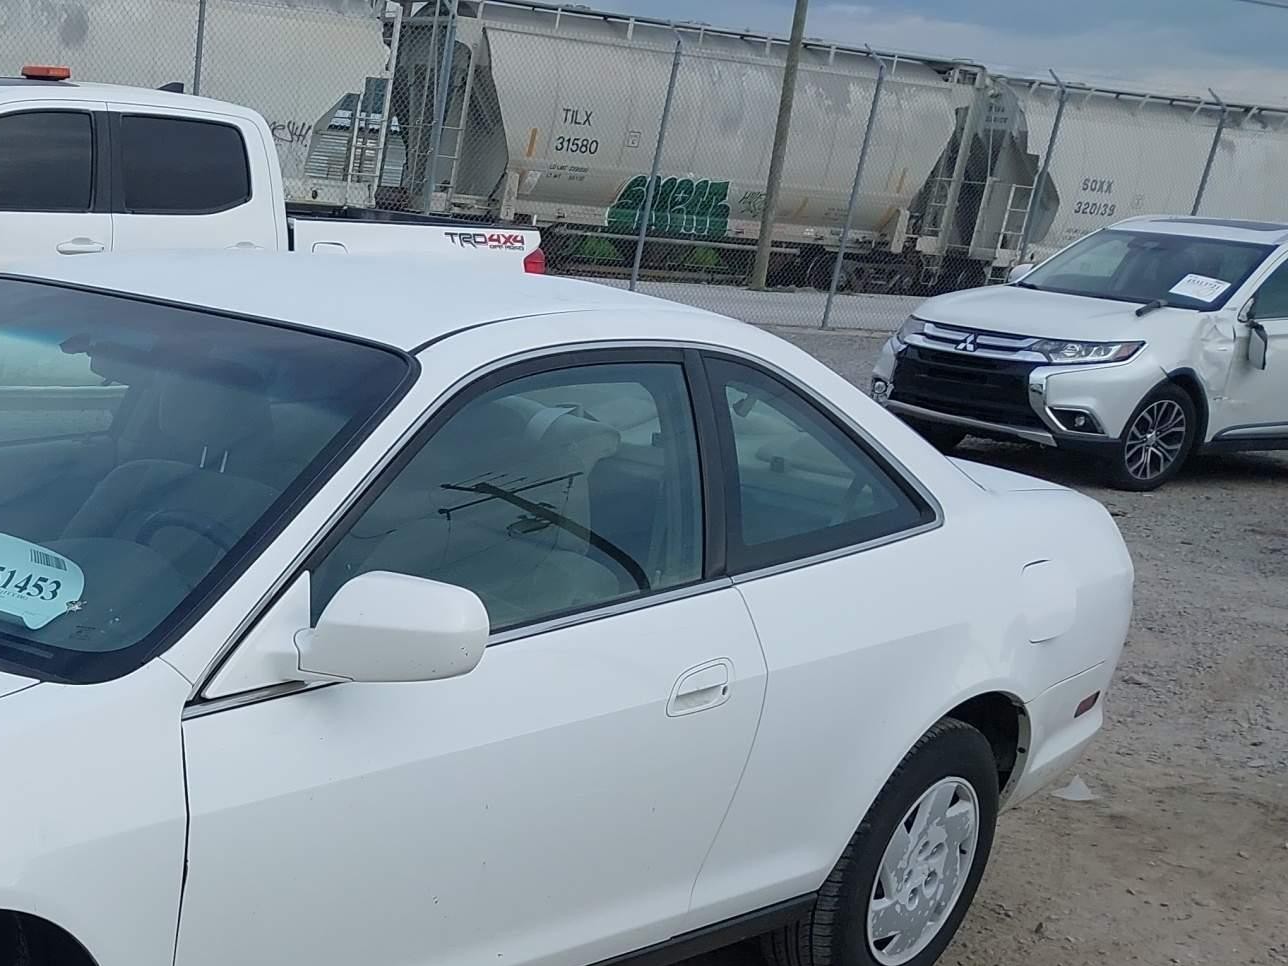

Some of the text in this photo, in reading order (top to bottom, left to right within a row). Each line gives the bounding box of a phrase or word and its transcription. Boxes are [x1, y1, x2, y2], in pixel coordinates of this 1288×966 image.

[563, 108, 593, 126] TILX
[555, 136, 599, 155] 31580
[1081, 178, 1114, 194] SOXX
[1073, 201, 1116, 217] 320139
